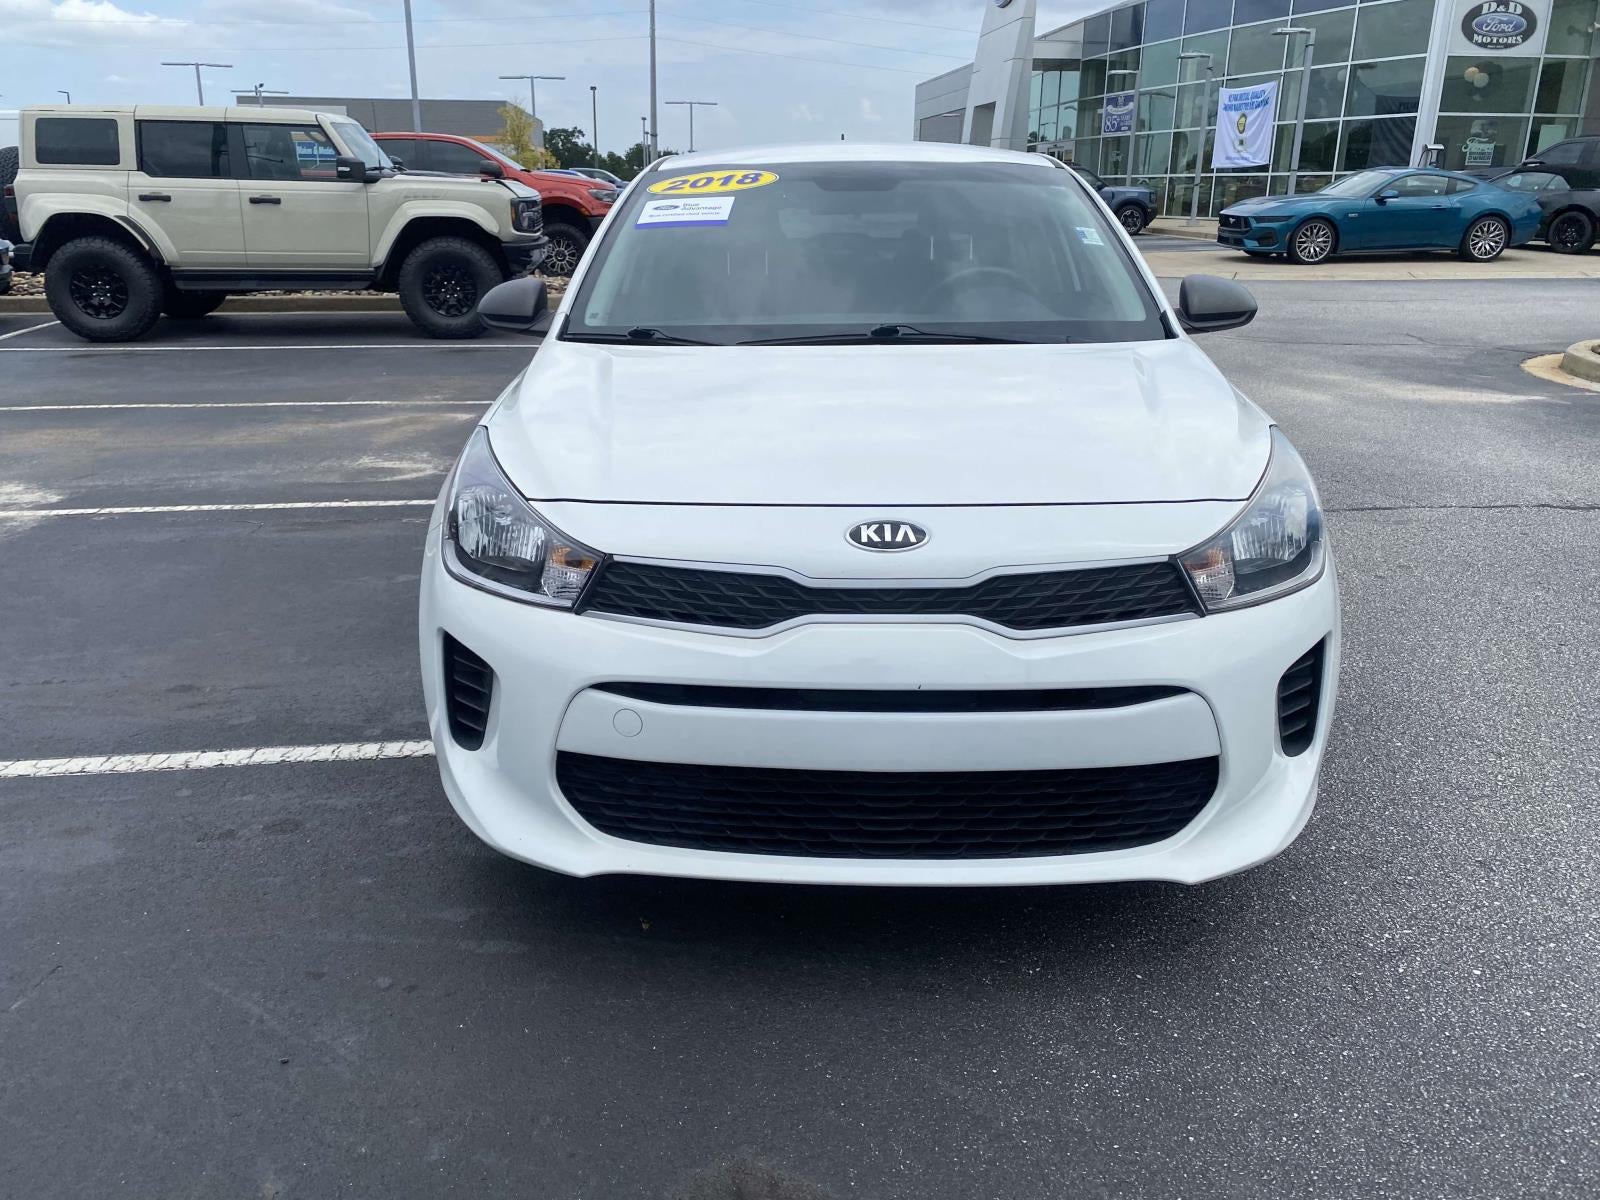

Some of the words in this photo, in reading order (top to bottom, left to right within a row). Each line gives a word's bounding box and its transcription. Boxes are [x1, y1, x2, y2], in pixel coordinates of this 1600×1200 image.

[1481, 1, 1523, 14] D&D
[1483, 15, 1517, 32] Ford
[1473, 33, 1523, 44] MOTORS
[662, 172, 763, 191] 2018
[860, 523, 917, 543] KIA
